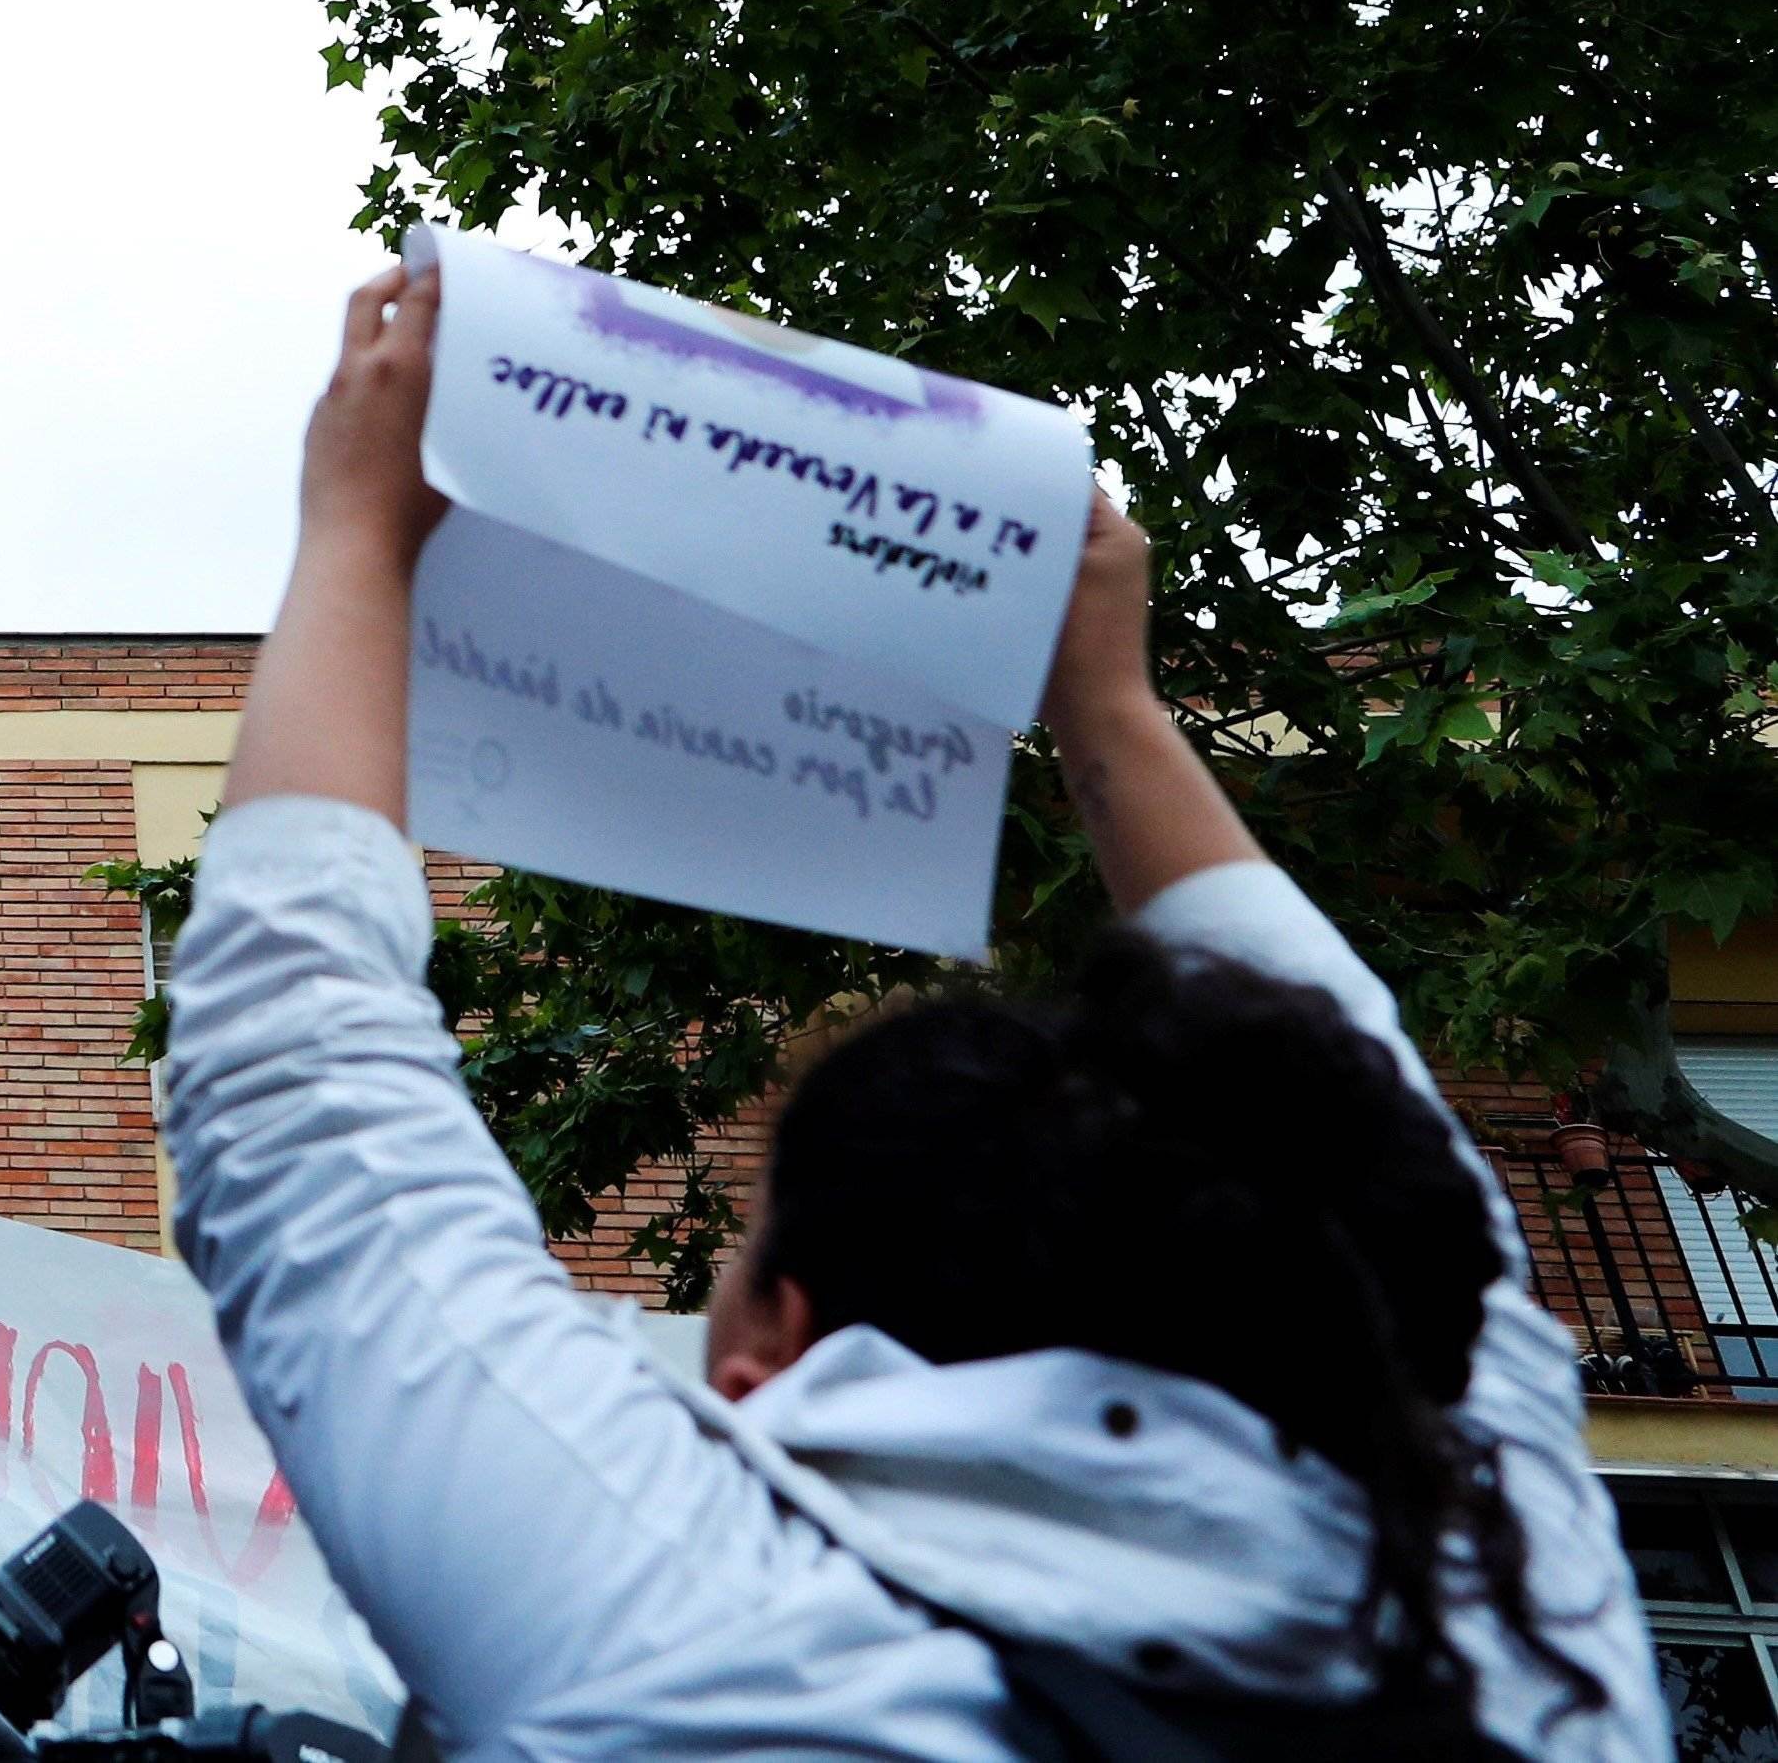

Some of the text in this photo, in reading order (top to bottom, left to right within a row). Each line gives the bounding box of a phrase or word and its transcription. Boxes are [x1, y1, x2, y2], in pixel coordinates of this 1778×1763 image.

[490, 355, 1039, 556] ni a la Verneda ni enlloc
[828, 521, 988, 594] violadors
